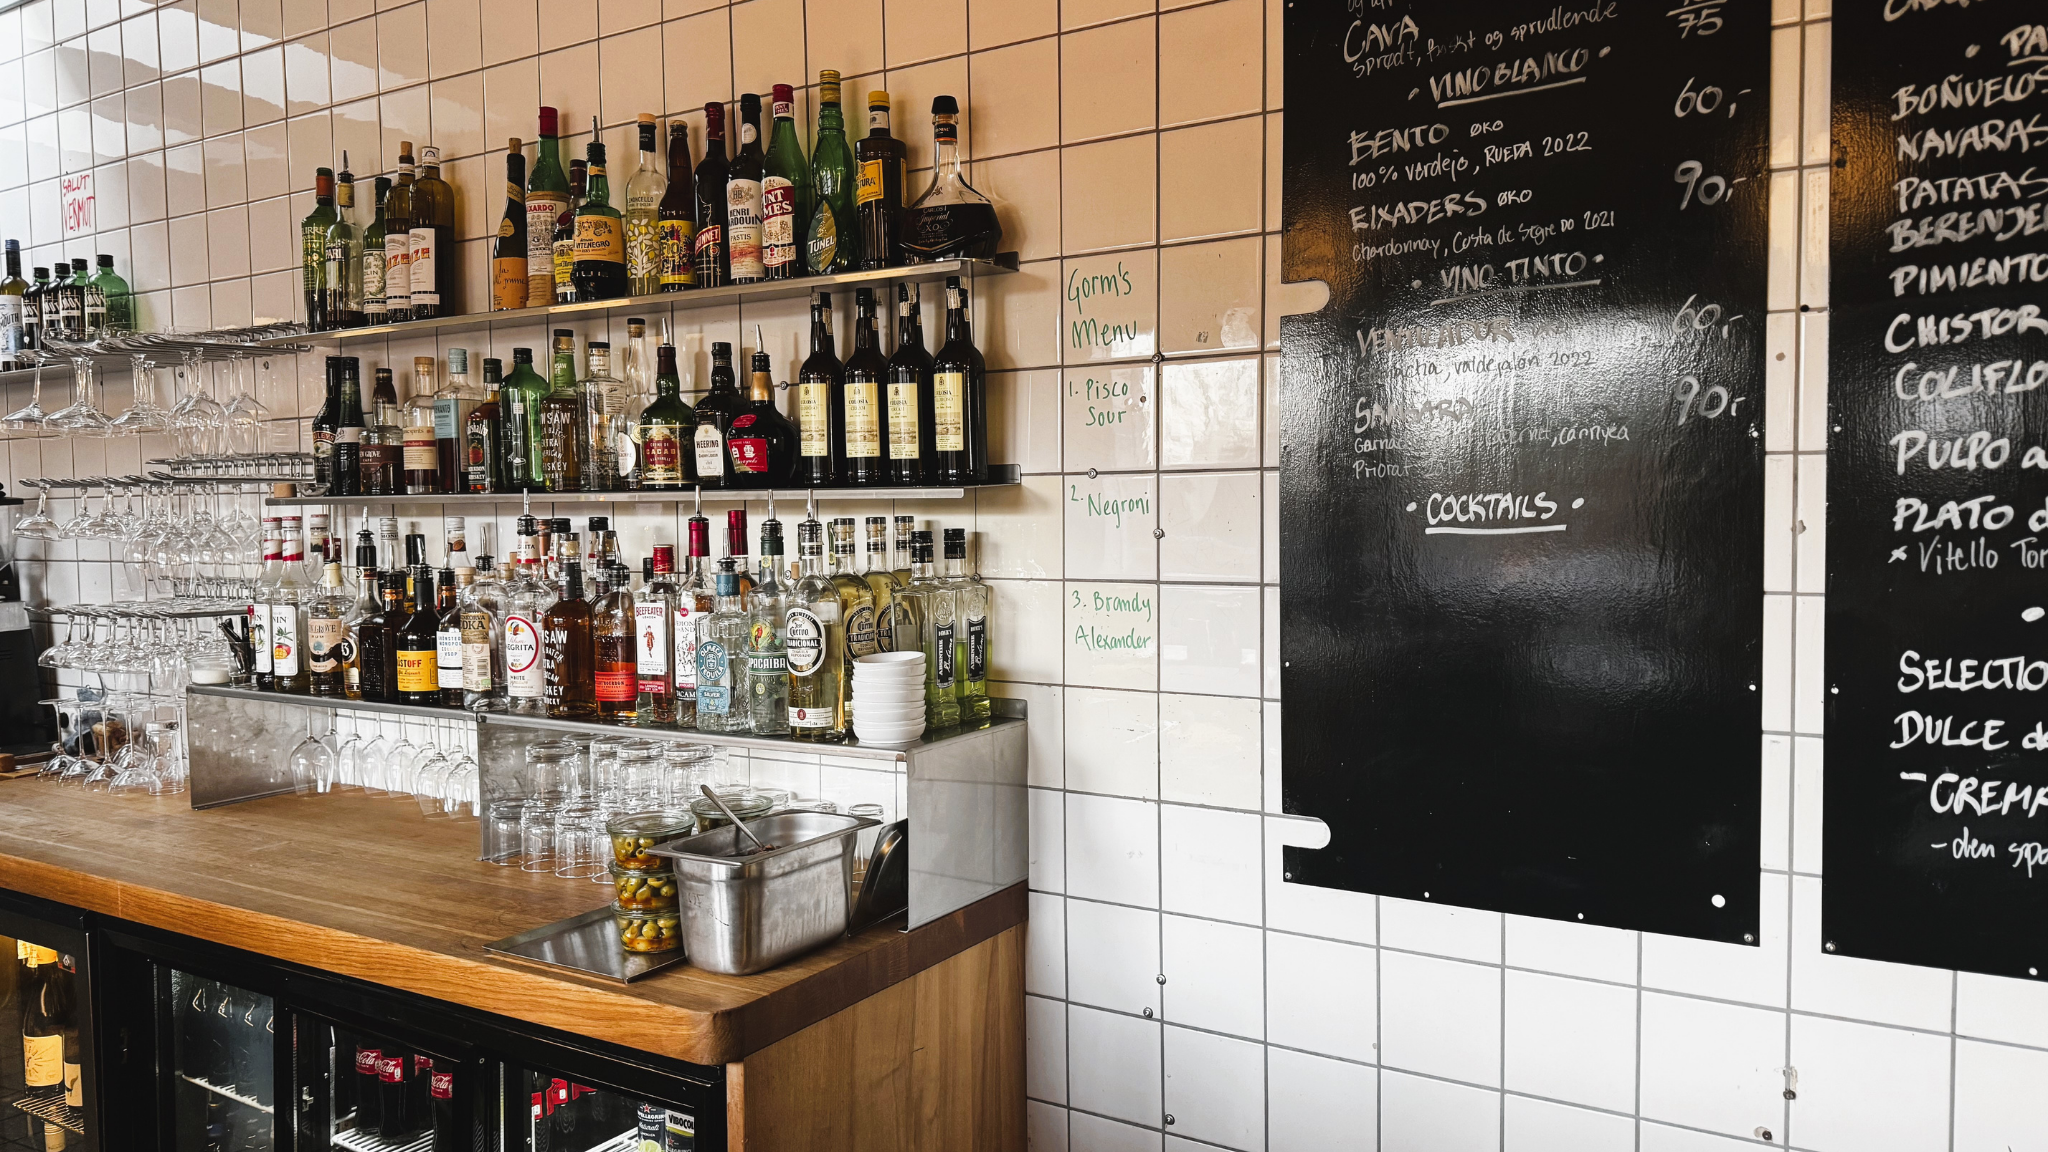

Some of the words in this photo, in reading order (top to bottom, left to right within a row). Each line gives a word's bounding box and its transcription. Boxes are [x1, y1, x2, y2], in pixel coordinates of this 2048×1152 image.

[1343, 14, 1420, 63] CAVA
[1485, 31, 1503, 50] og
[1511, 1, 1618, 42] sprudlende
[1678, 8, 1723, 39] 75
[2000, 24, 2048, 57] PA
[1347, 122, 1450, 166] BENTO
[1352, 165, 1398, 191] 100%
[1484, 141, 1533, 167] RUEDA
[1542, 131, 1592, 157] 2022
[63, 174, 90, 197] SALUT
[1893, 167, 2048, 213] PATATAS
[1348, 189, 1487, 232] EIXADERS
[1885, 203, 2048, 252] BERENJE
[730, 233, 752, 241] PASTIS
[1453, 225, 1493, 254] Costa
[1497, 225, 1515, 245] de
[1584, 210, 1615, 230] 2021
[1068, 261, 1132, 315] Gorm's
[1440, 263, 1495, 293] VINO
[1504, 250, 1587, 283] TINTO
[1072, 317, 1137, 349] Menu
[1356, 313, 1515, 358] VENTILADOR
[1885, 304, 2048, 353] CHISTOR
[1548, 350, 1597, 367] 2022
[1069, 380, 1079, 397] 1.
[1086, 378, 1129, 401] Pisco
[1085, 406, 1127, 427] Sour
[696, 439, 719, 448] HEERING
[1889, 430, 2010, 475] PULPO
[1353, 457, 1413, 480] Priorat
[1071, 484, 1084, 502] 2.
[1088, 491, 1150, 529] Negroni
[1426, 491, 1558, 525] COCKTAILS
[1893, 495, 2014, 532] PLATO
[1918, 535, 1999, 574] Vitello
[636, 607, 663, 617] BEEFEATER
[1072, 590, 1087, 609] 3.
[1093, 591, 1151, 623] Brandy
[700, 643, 723, 658] OLMECA
[1075, 624, 1151, 651] Alexander
[700, 664, 724, 679] TEQUILA
[749, 656, 786, 669] PACAÏBA
[1890, 711, 2009, 750] DULCE
